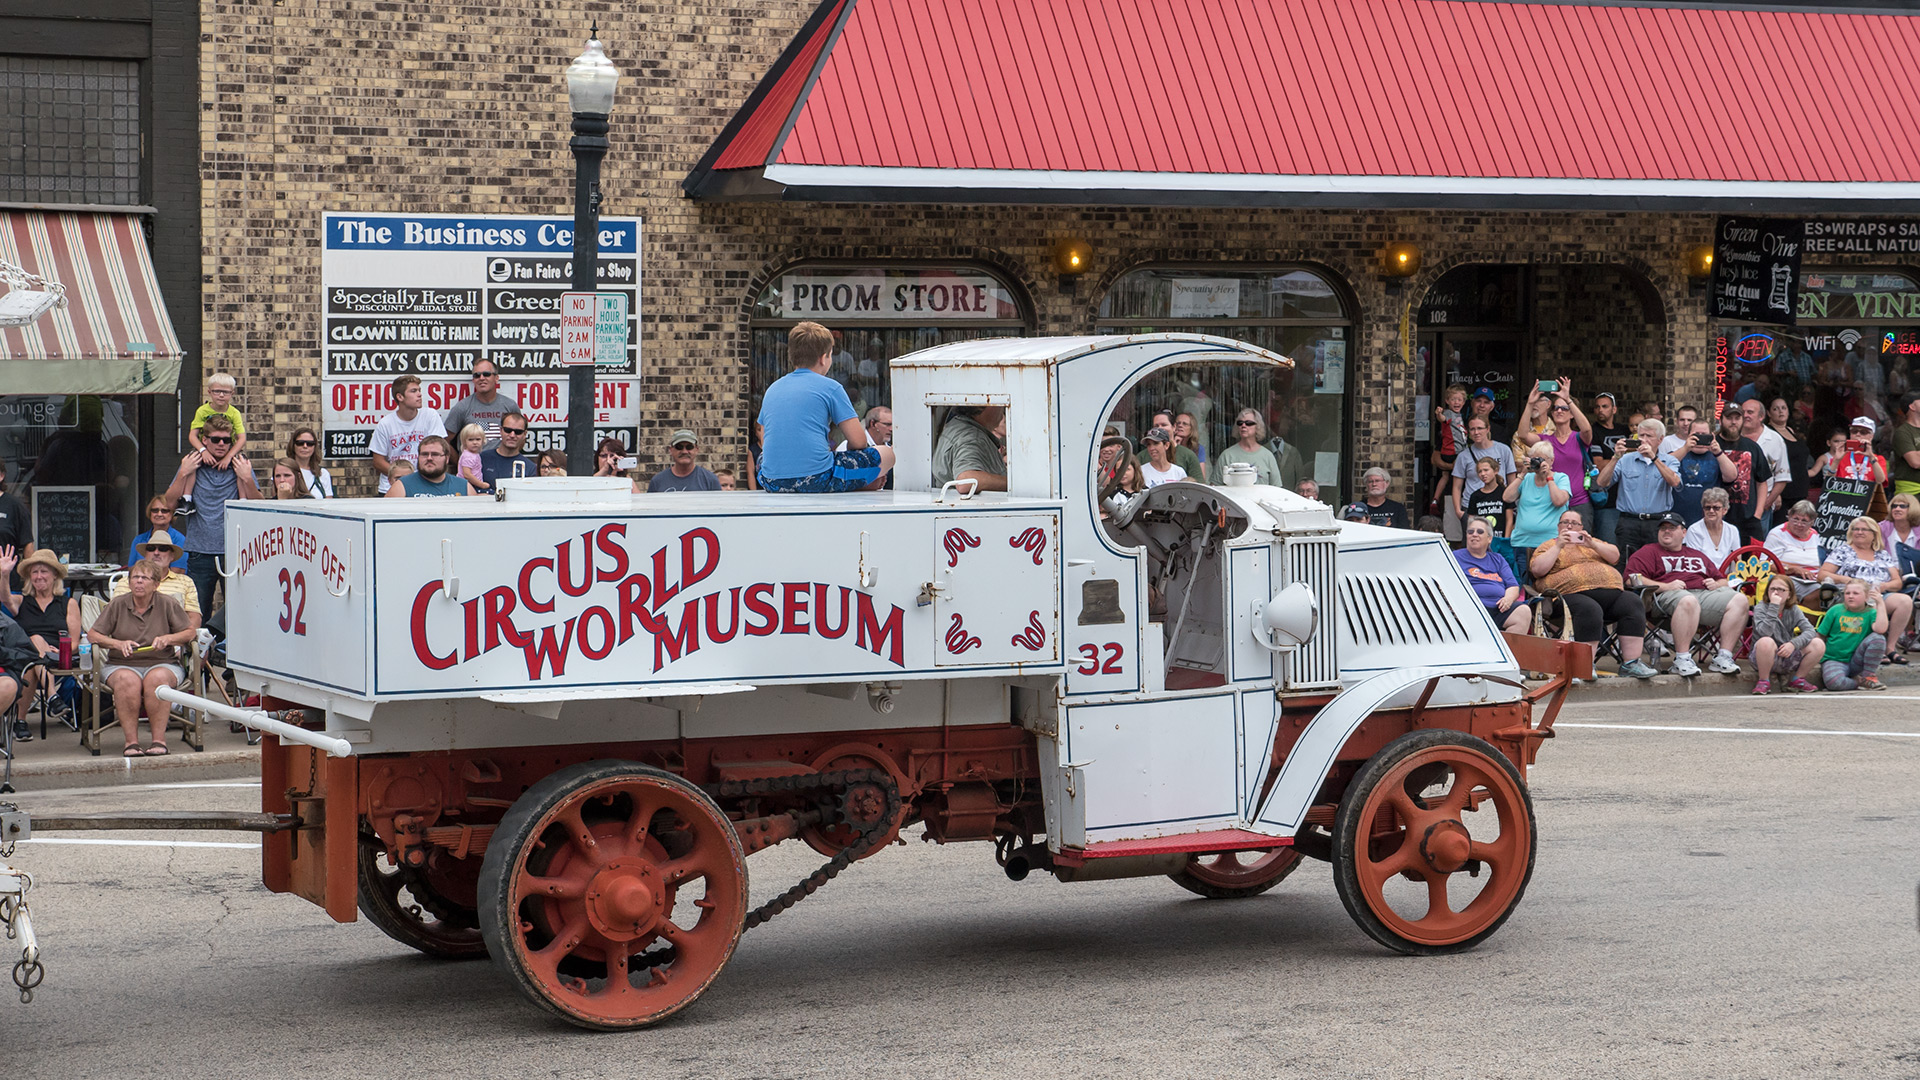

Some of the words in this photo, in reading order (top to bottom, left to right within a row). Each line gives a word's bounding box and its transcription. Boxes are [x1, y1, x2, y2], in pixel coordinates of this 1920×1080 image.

[338, 221, 392, 244] The
[404, 221, 526, 245] Business
[1804, 222, 1824, 235] ES
[1723, 220, 1759, 242] Green
[1762, 232, 1798, 257] Vine
[1805, 239, 1836, 251] REE
[1845, 239, 1873, 251] ALL
[1877, 239, 1920, 251] NATU
[1726, 249, 1761, 263] Smoothies
[514, 263, 532, 279] Fan
[536, 263, 561, 279] Faire
[608, 262, 632, 281] Shop
[332, 289, 418, 309] Specially
[421, 290, 463, 305] Hers
[467, 291, 477, 305] II
[573, 299, 585, 310] NO
[603, 299, 618, 309] TWO
[792, 284, 880, 312] PROM
[894, 284, 987, 312] STORE
[1796, 292, 1830, 318] EN
[1853, 292, 1920, 318] VINE
[564, 316, 592, 327] PARKING
[600, 311, 620, 322] HOUR
[1430, 311, 1447, 323] 102
[331, 325, 397, 341] CLOWN
[401, 326, 429, 341] HALL
[432, 326, 446, 341] OF
[449, 326, 479, 341] FAME
[492, 322, 539, 343] Jerry's
[595, 323, 624, 334] PARKING
[568, 332, 573, 343] 2
[575, 332, 588, 343] AM
[1805, 336, 1836, 351] WiFi
[1897, 333, 1916, 343] ICE
[578, 348, 591, 358] AM
[1735, 339, 1775, 357] OPEN
[1890, 343, 1920, 354] CREAM
[332, 352, 408, 372] TRACY'S
[415, 352, 474, 372] CHAIR
[493, 351, 516, 369] It's
[521, 351, 546, 369] All
[1447, 371, 1480, 383] Tracy's
[1483, 370, 1515, 383] Chair
[332, 383, 399, 411] OFFIC
[517, 382, 559, 410] FOR
[0, 403, 56, 422] ounge
[331, 433, 365, 444] 12x12
[390, 434, 424, 448] RAMS
[331, 445, 371, 456] Starting
[1826, 477, 1853, 492] Green
[1822, 501, 1864, 517] Smoothies
[241, 526, 284, 576] DANGER
[289, 526, 317, 563] KEEP
[321, 545, 346, 590] OFF
[1665, 556, 1703, 571] YES
[278, 567, 306, 637] 32
[410, 522, 629, 670] CIRCUS
[522, 527, 721, 681] WORLD
[652, 582, 906, 675] MUSEUM
[1077, 643, 1123, 676] 32
